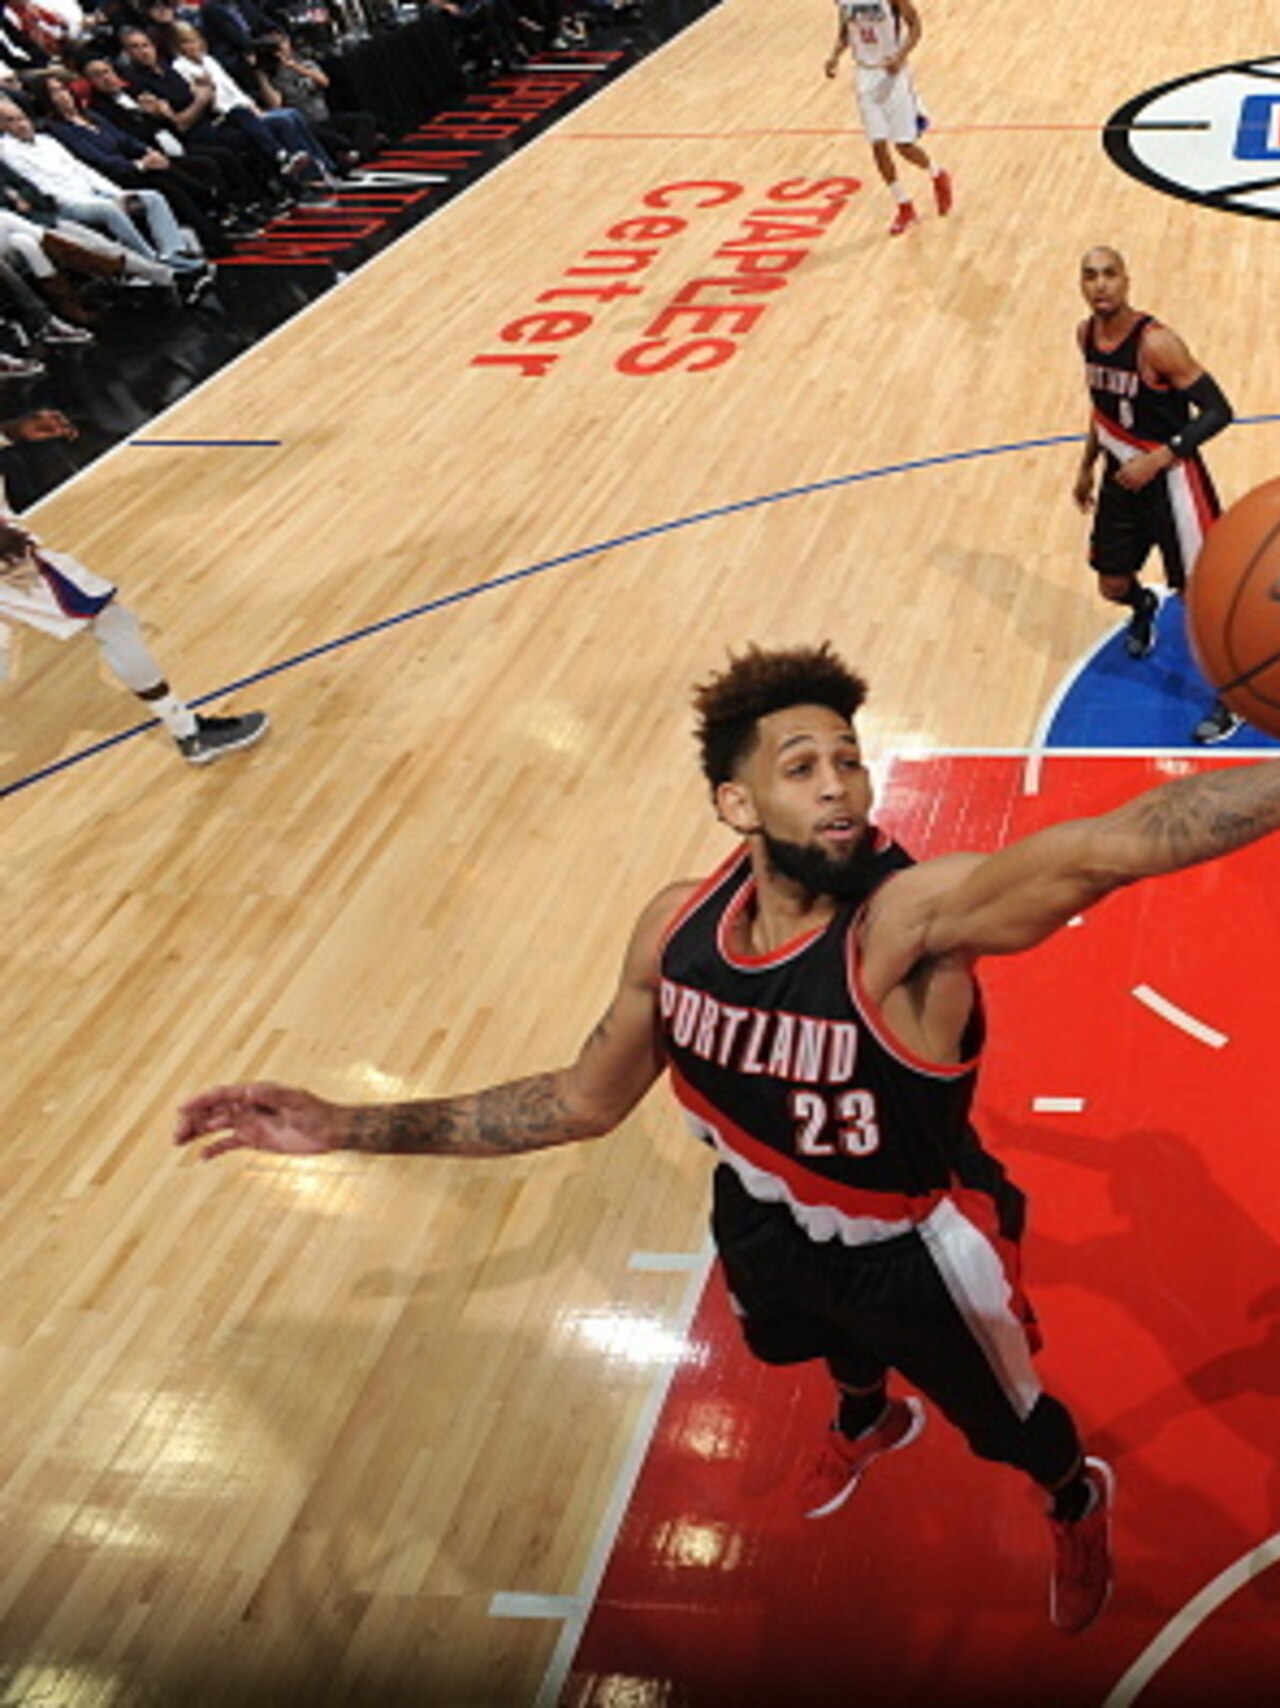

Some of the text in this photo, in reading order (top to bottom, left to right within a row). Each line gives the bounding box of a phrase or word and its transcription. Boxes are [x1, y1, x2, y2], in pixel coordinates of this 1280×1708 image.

[468, 179, 745, 377] Center
[614, 176, 862, 377] STAPLES
[658, 979, 858, 1083] PORTLAND
[793, 1090, 881, 1155] 23
